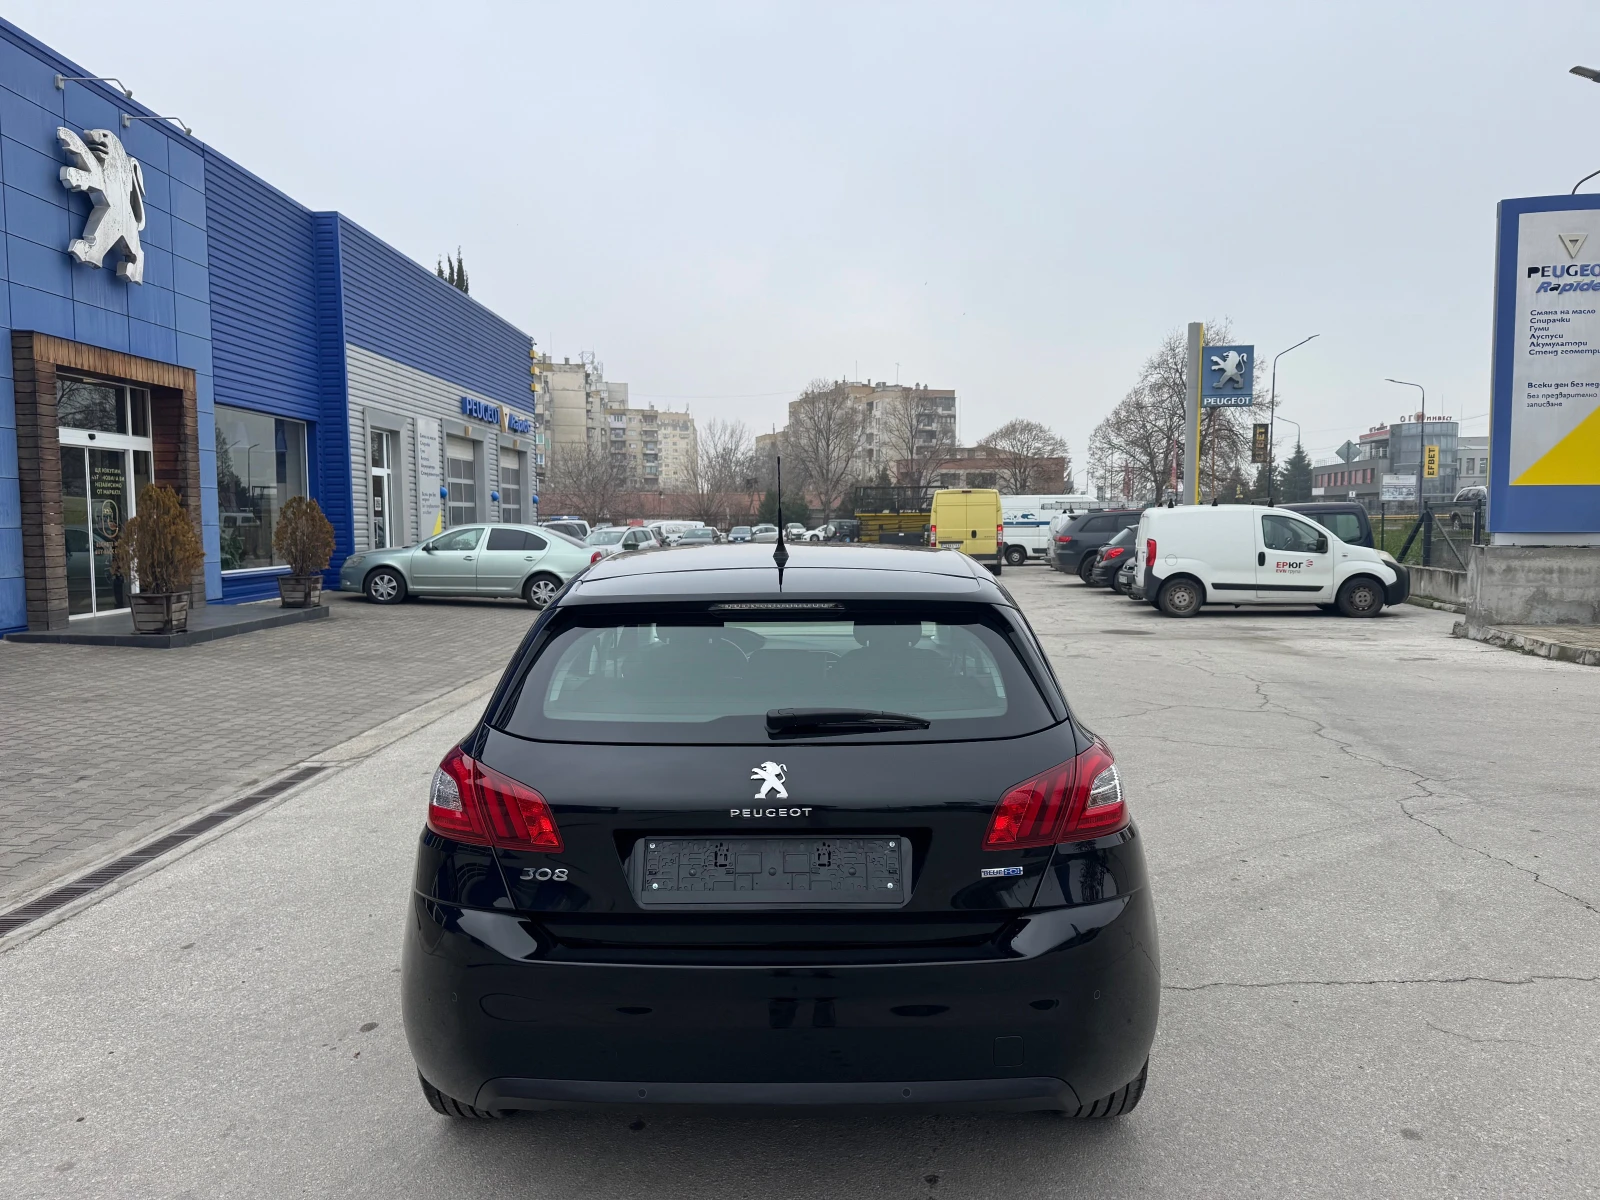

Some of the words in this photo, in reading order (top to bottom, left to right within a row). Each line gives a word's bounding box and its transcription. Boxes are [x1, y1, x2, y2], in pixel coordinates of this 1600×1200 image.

[1529, 316, 1571, 325] Спирачки
[1529, 325, 1550, 334] Гуми
[1529, 333, 1564, 341] Ауспуси
[1528, 341, 1588, 349] Акумулатори
[1553, 382, 1569, 390] ден
[1570, 380, 1584, 388] без
[1526, 392, 1540, 400] без
[1541, 391, 1598, 400] предварително
[1203, 396, 1251, 406] PEUGEOT
[1526, 400, 1563, 408] записване
[466, 397, 501, 425] PEUGEOT
[1427, 447, 1436, 476] EFBET
[730, 807, 813, 818] PEUGEOT
[519, 867, 569, 882] 308
